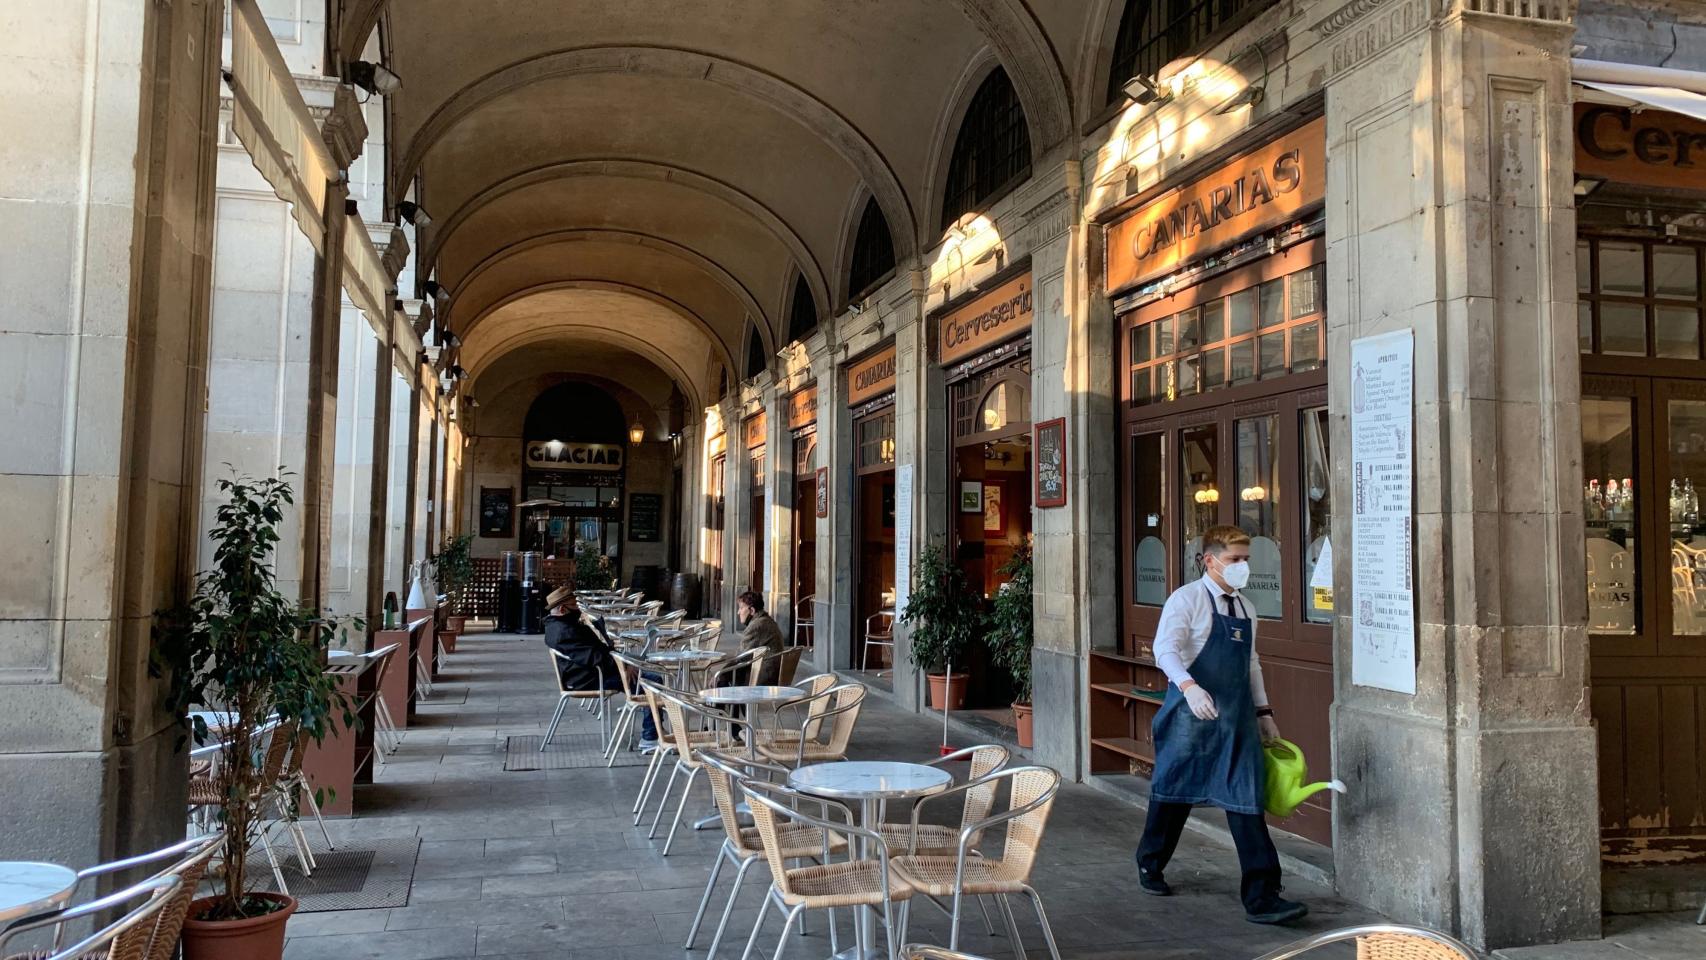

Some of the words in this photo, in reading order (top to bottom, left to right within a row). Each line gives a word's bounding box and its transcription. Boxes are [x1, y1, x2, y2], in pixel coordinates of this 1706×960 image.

[1578, 105, 1706, 168] Cer
[1133, 148, 1301, 261] CANARIAS
[528, 445, 620, 465] GLACIAR
[1245, 582, 1280, 591] ANARIAS
